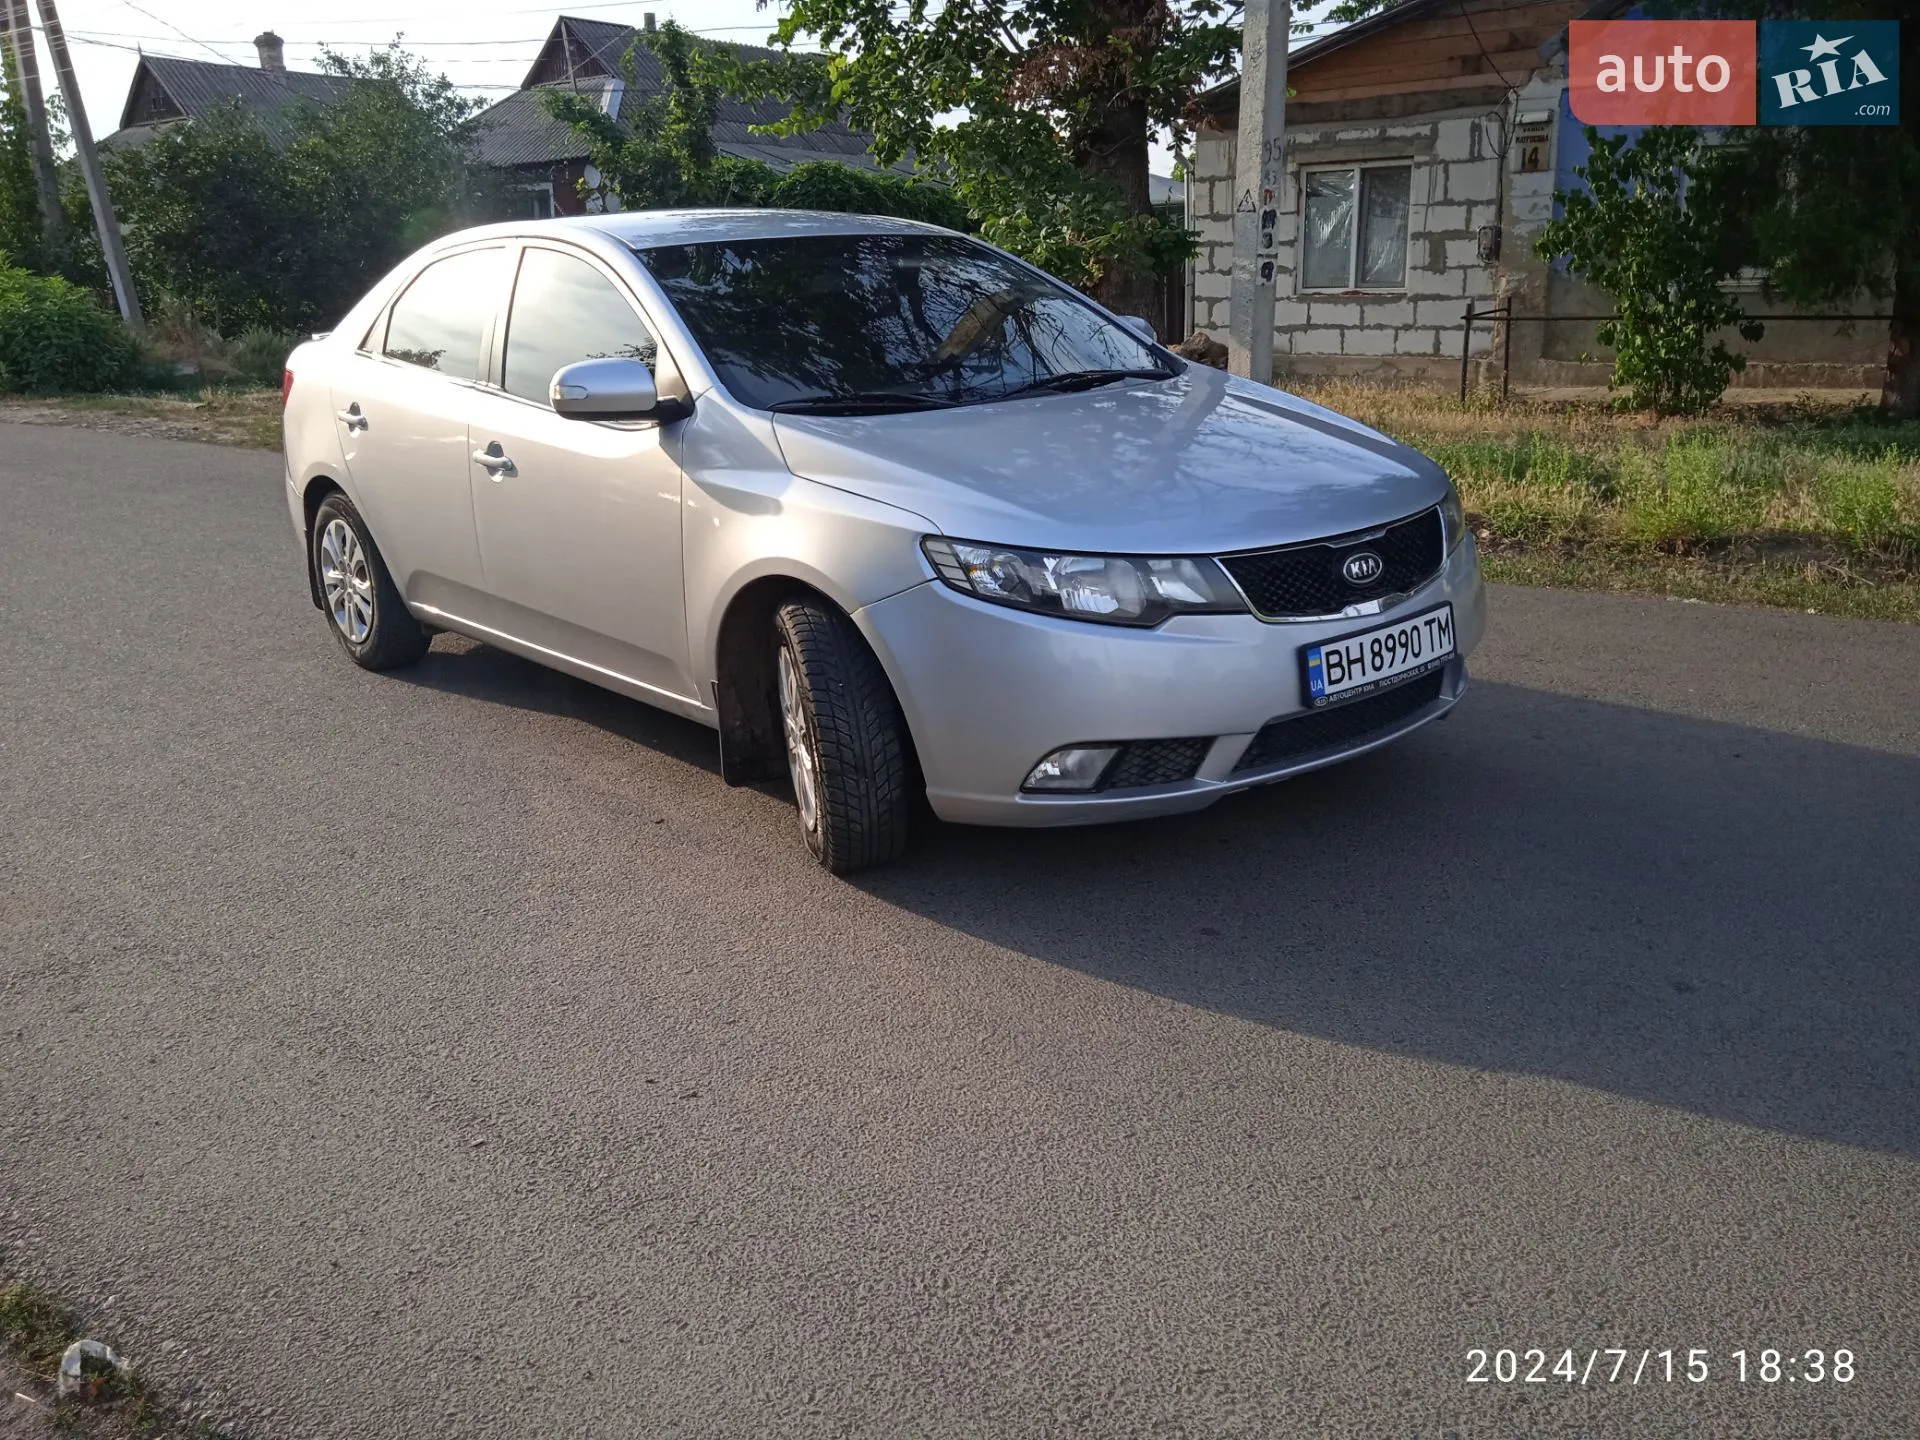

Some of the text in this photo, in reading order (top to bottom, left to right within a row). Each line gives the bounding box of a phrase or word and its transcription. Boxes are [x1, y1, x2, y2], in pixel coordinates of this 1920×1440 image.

[1521, 147, 1541, 171] 14
[1349, 558, 1378, 579] KIA
[1325, 642, 1367, 686] BH
[1370, 625, 1422, 672] 8990
[1424, 613, 1452, 653] TM
[1310, 678, 1324, 692] UA
